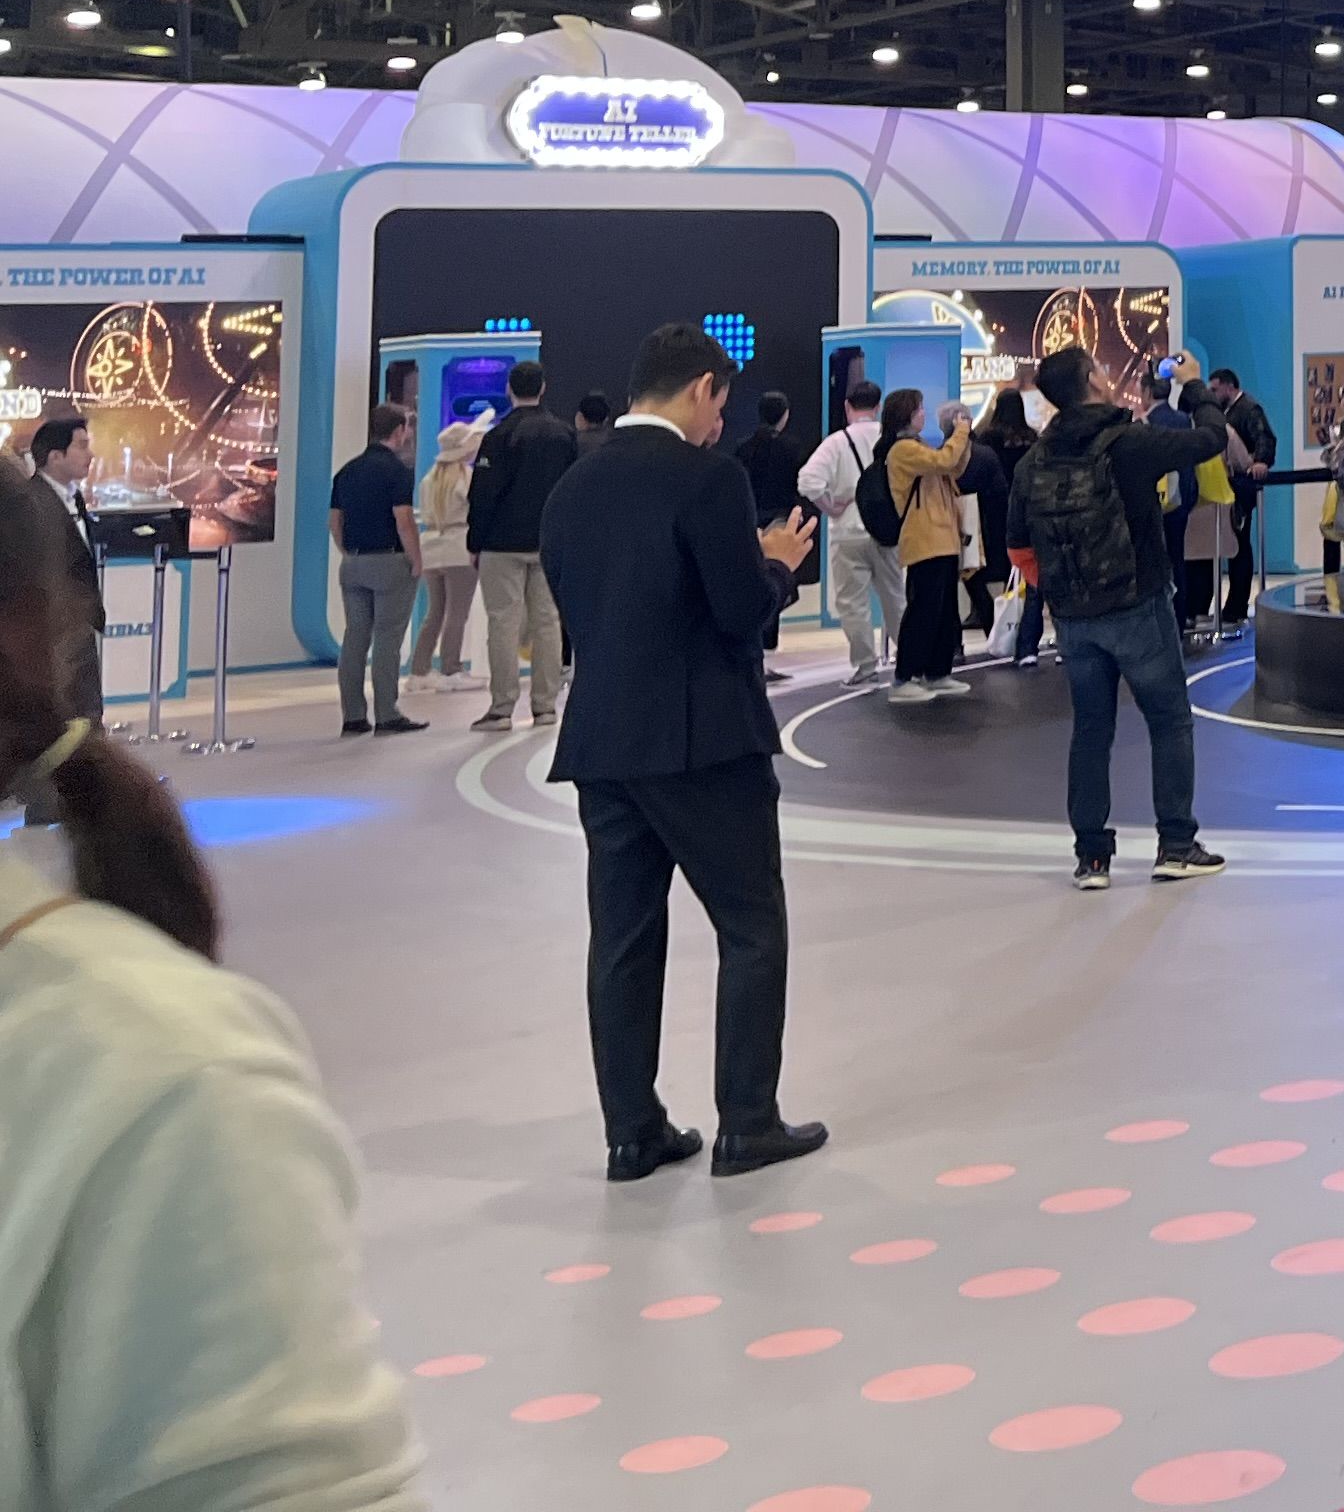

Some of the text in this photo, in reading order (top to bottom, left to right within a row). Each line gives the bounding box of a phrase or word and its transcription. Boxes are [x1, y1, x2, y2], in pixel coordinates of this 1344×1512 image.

[604, 99, 637, 123] AI
[538, 122, 697, 144] FORTUNE TELLER
[8, 268, 206, 286] THE POWER OF AI
[912, 260, 1120, 277] MEMORY, THE POWER OF AI
[1323, 286, 1337, 299] AI
